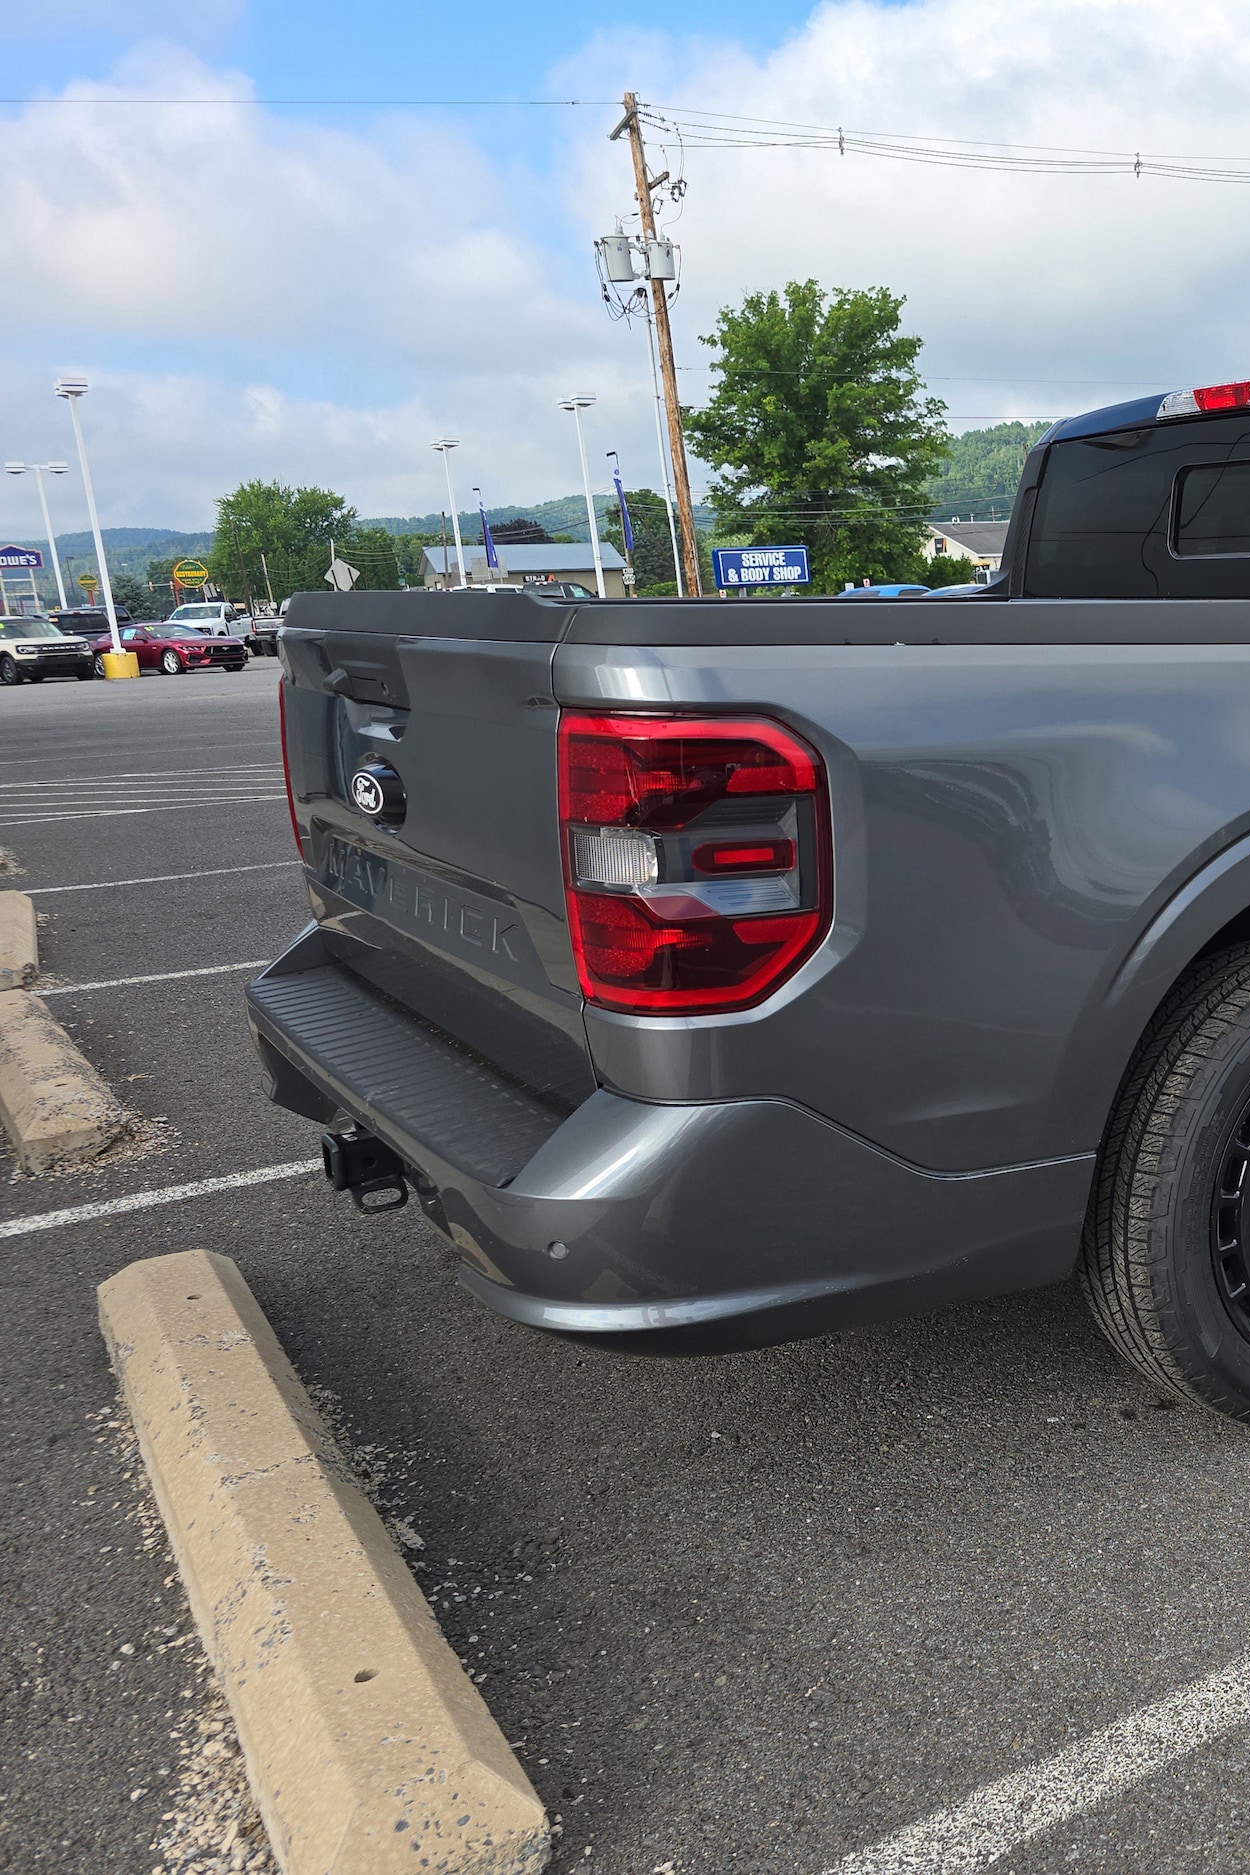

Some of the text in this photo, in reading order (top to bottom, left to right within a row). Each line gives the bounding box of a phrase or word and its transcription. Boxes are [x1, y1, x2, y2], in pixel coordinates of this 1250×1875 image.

[0, 554, 37, 566] OWE'S
[741, 552, 786, 567] SERVICE
[728, 566, 802, 582] & BODY SHOP
[356, 776, 377, 809] Ford
[328, 843, 520, 964] MAVERICK
